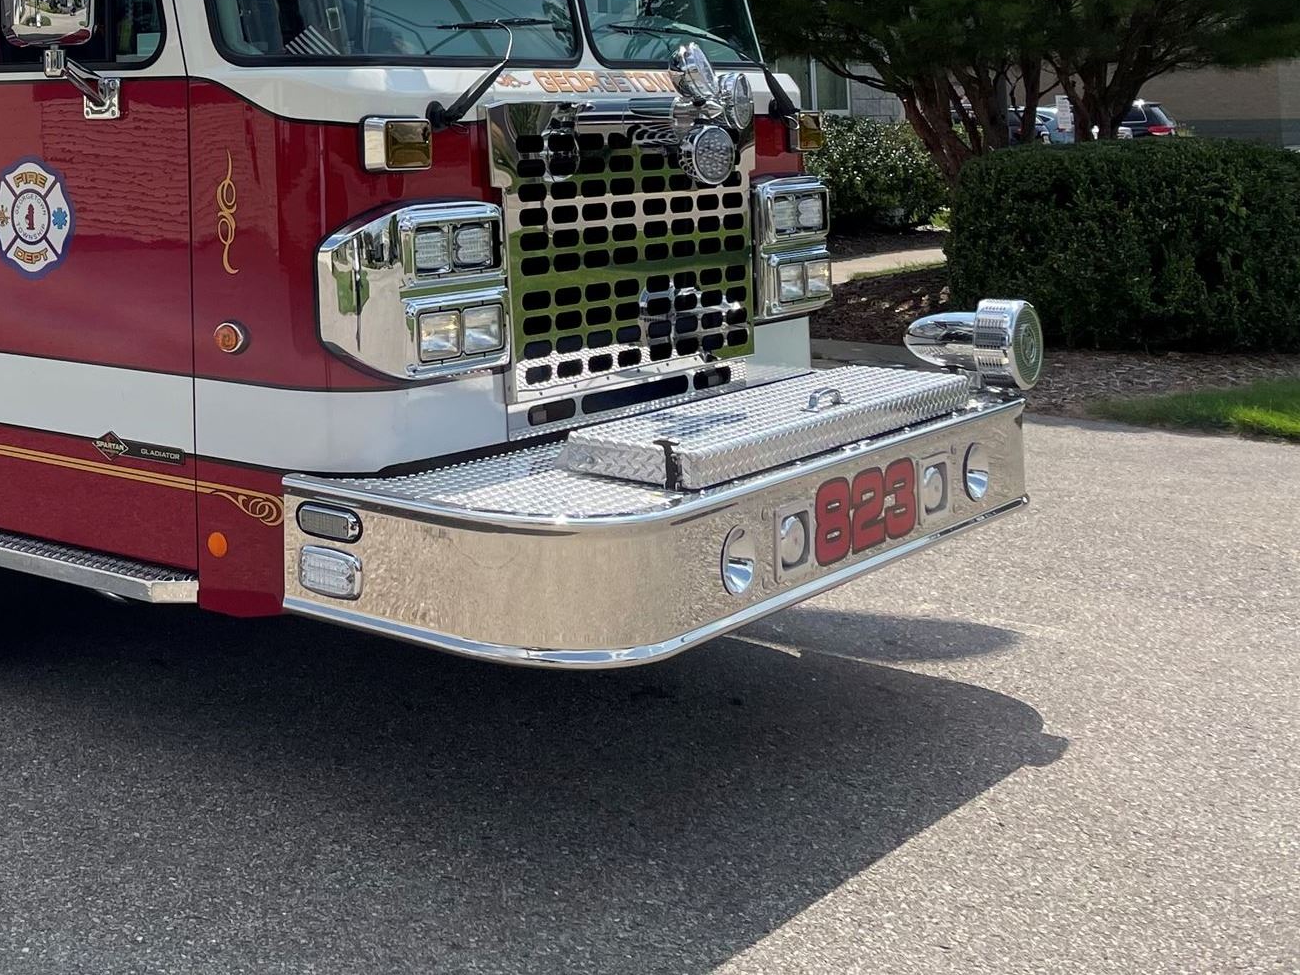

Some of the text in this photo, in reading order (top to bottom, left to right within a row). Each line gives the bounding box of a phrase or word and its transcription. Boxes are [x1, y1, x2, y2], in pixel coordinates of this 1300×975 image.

[533, 71, 677, 93] GEORGETOW
[13, 171, 48, 188] FIRE
[14, 246, 49, 264] DEPT
[96, 440, 125, 452] SPARTAN
[140, 447, 180, 461] GLADIATOR
[814, 456, 917, 567] 823
